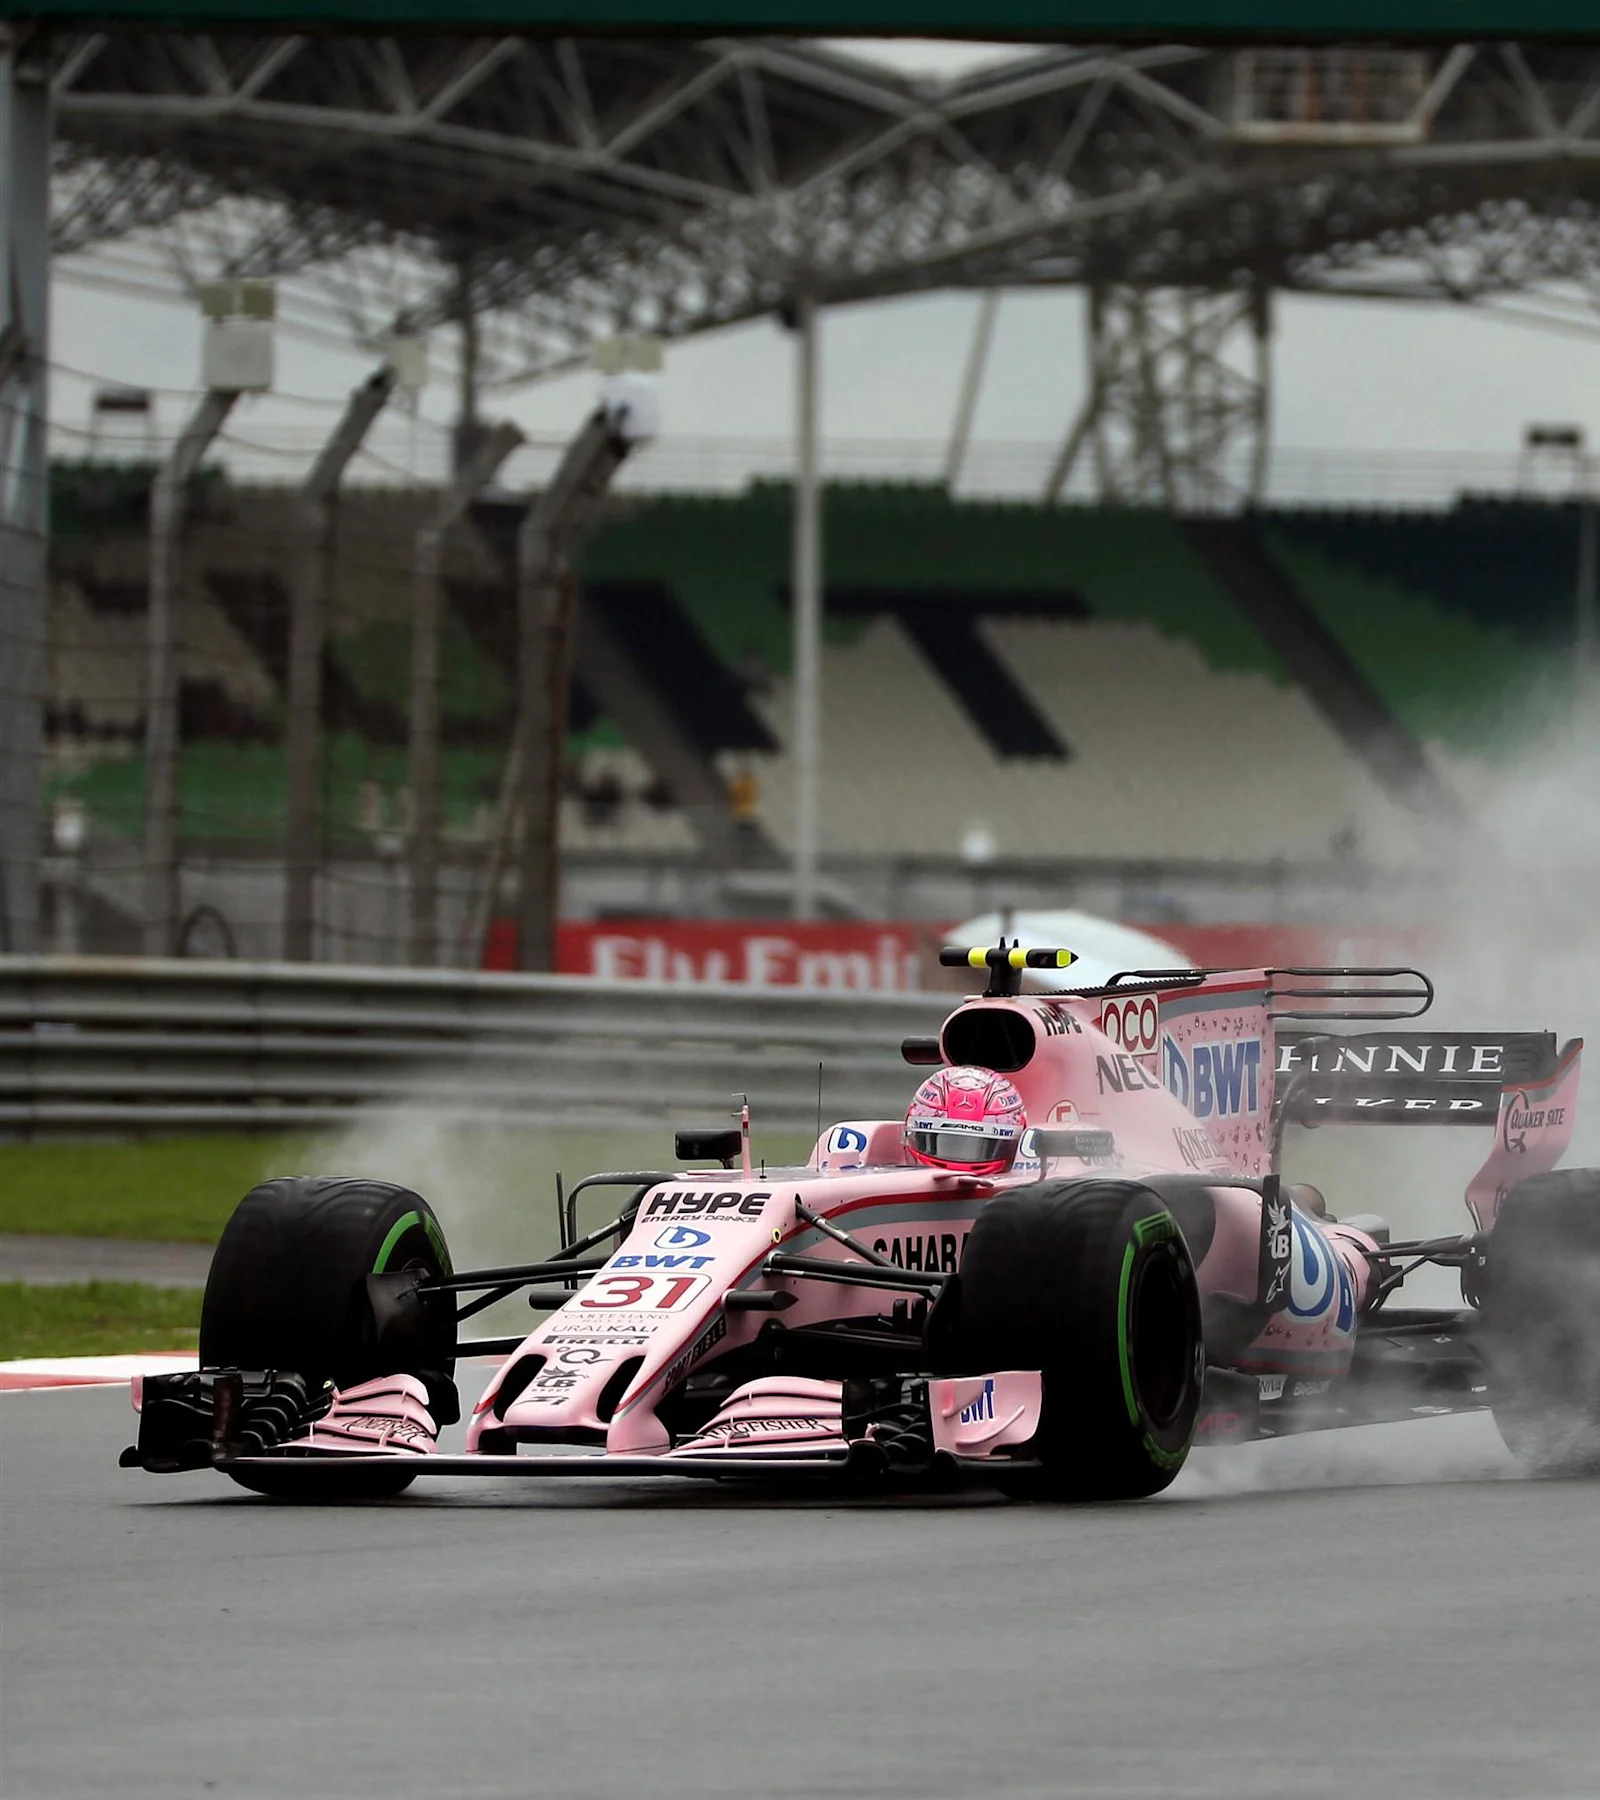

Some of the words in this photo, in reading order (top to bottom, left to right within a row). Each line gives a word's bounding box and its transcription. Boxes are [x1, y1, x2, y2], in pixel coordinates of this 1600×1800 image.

[1032, 1004, 1083, 1037] HYPE
[1095, 1053, 1161, 1096] NEC
[1192, 1039, 1262, 1118] BWT
[644, 1191, 773, 1216] HYPE
[640, 1214, 701, 1224] ENERGY
[703, 1214, 759, 1223] DRINKS
[610, 1254, 717, 1269] BWT
[579, 1275, 698, 1310] 31
[551, 1325, 659, 1333] URALKALI
